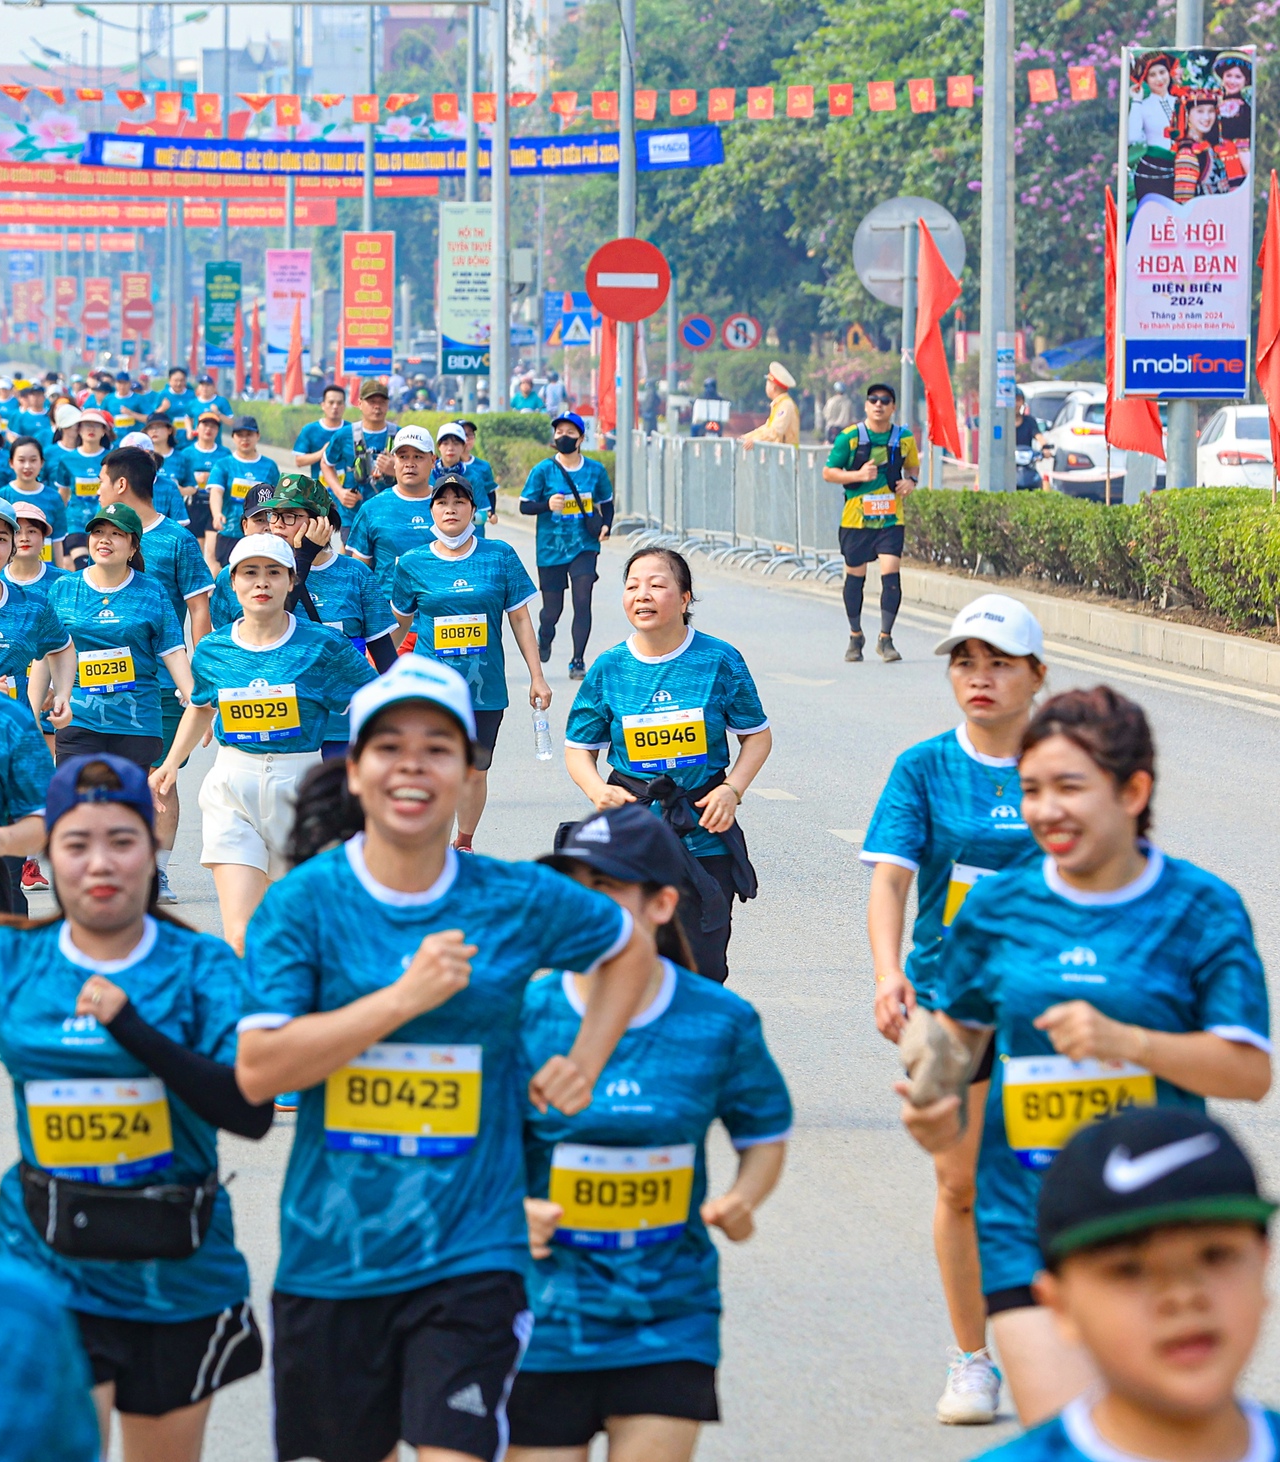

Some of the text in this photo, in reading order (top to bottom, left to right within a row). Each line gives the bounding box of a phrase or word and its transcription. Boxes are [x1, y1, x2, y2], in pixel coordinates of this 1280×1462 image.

[1151, 216, 1225, 245] LỄ HỘI
[1138, 255, 1237, 273] HOA BAN
[1152, 281, 1223, 295] ĐIỆN BIÊN
[1170, 296, 1204, 306] 2024
[1151, 311, 1176, 321] Tháng
[1185, 311, 1202, 320] năm
[1204, 312, 1223, 320] 2024
[447, 355, 482, 370] BIDV
[1132, 353, 1244, 374] mobifone
[398, 434, 423, 442] CHANEL
[440, 626, 481, 640] 80876
[85, 660, 127, 676] 80238
[230, 702, 288, 719] 80929
[634, 726, 696, 748] 80946
[347, 1075, 461, 1110] 80423
[45, 1110, 151, 1142] 80524
[574, 1177, 673, 1208] 80391
